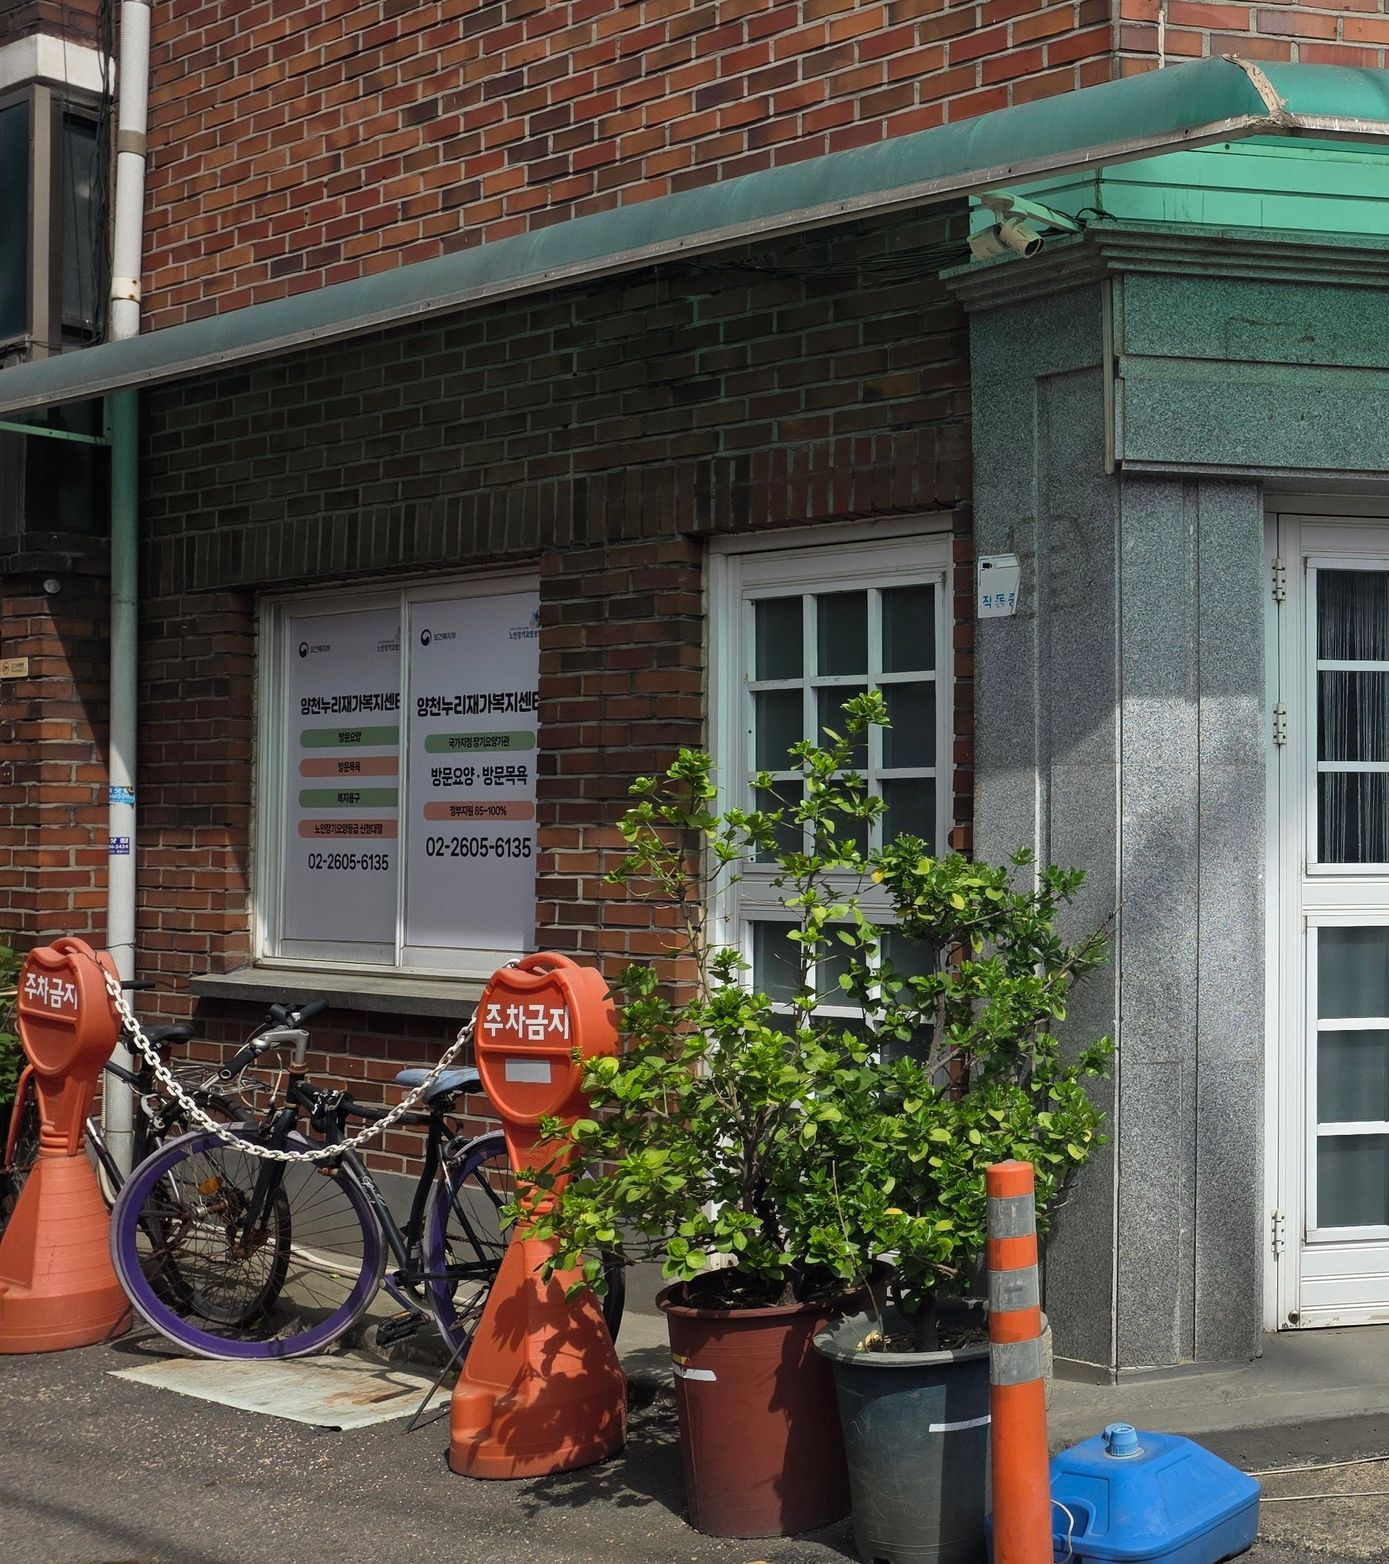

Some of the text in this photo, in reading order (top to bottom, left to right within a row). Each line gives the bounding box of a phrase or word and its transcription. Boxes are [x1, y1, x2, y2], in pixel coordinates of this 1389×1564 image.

[508, 630, 539, 640] 노인장기요양보
[338, 731, 362, 743] 방문요양
[448, 735, 511, 749] 국가지정 장기요양기관
[431, 766, 475, 787] 방문요양
[482, 765, 528, 786] 방문목욕
[449, 805, 507, 817] 정부지원 85~100%
[426, 836, 532, 858] 02-2605-6135
[307, 853, 389, 871] 02-2605-6135
[24, 972, 78, 1010] 주차금지
[483, 1003, 570, 1041] 주차금지
